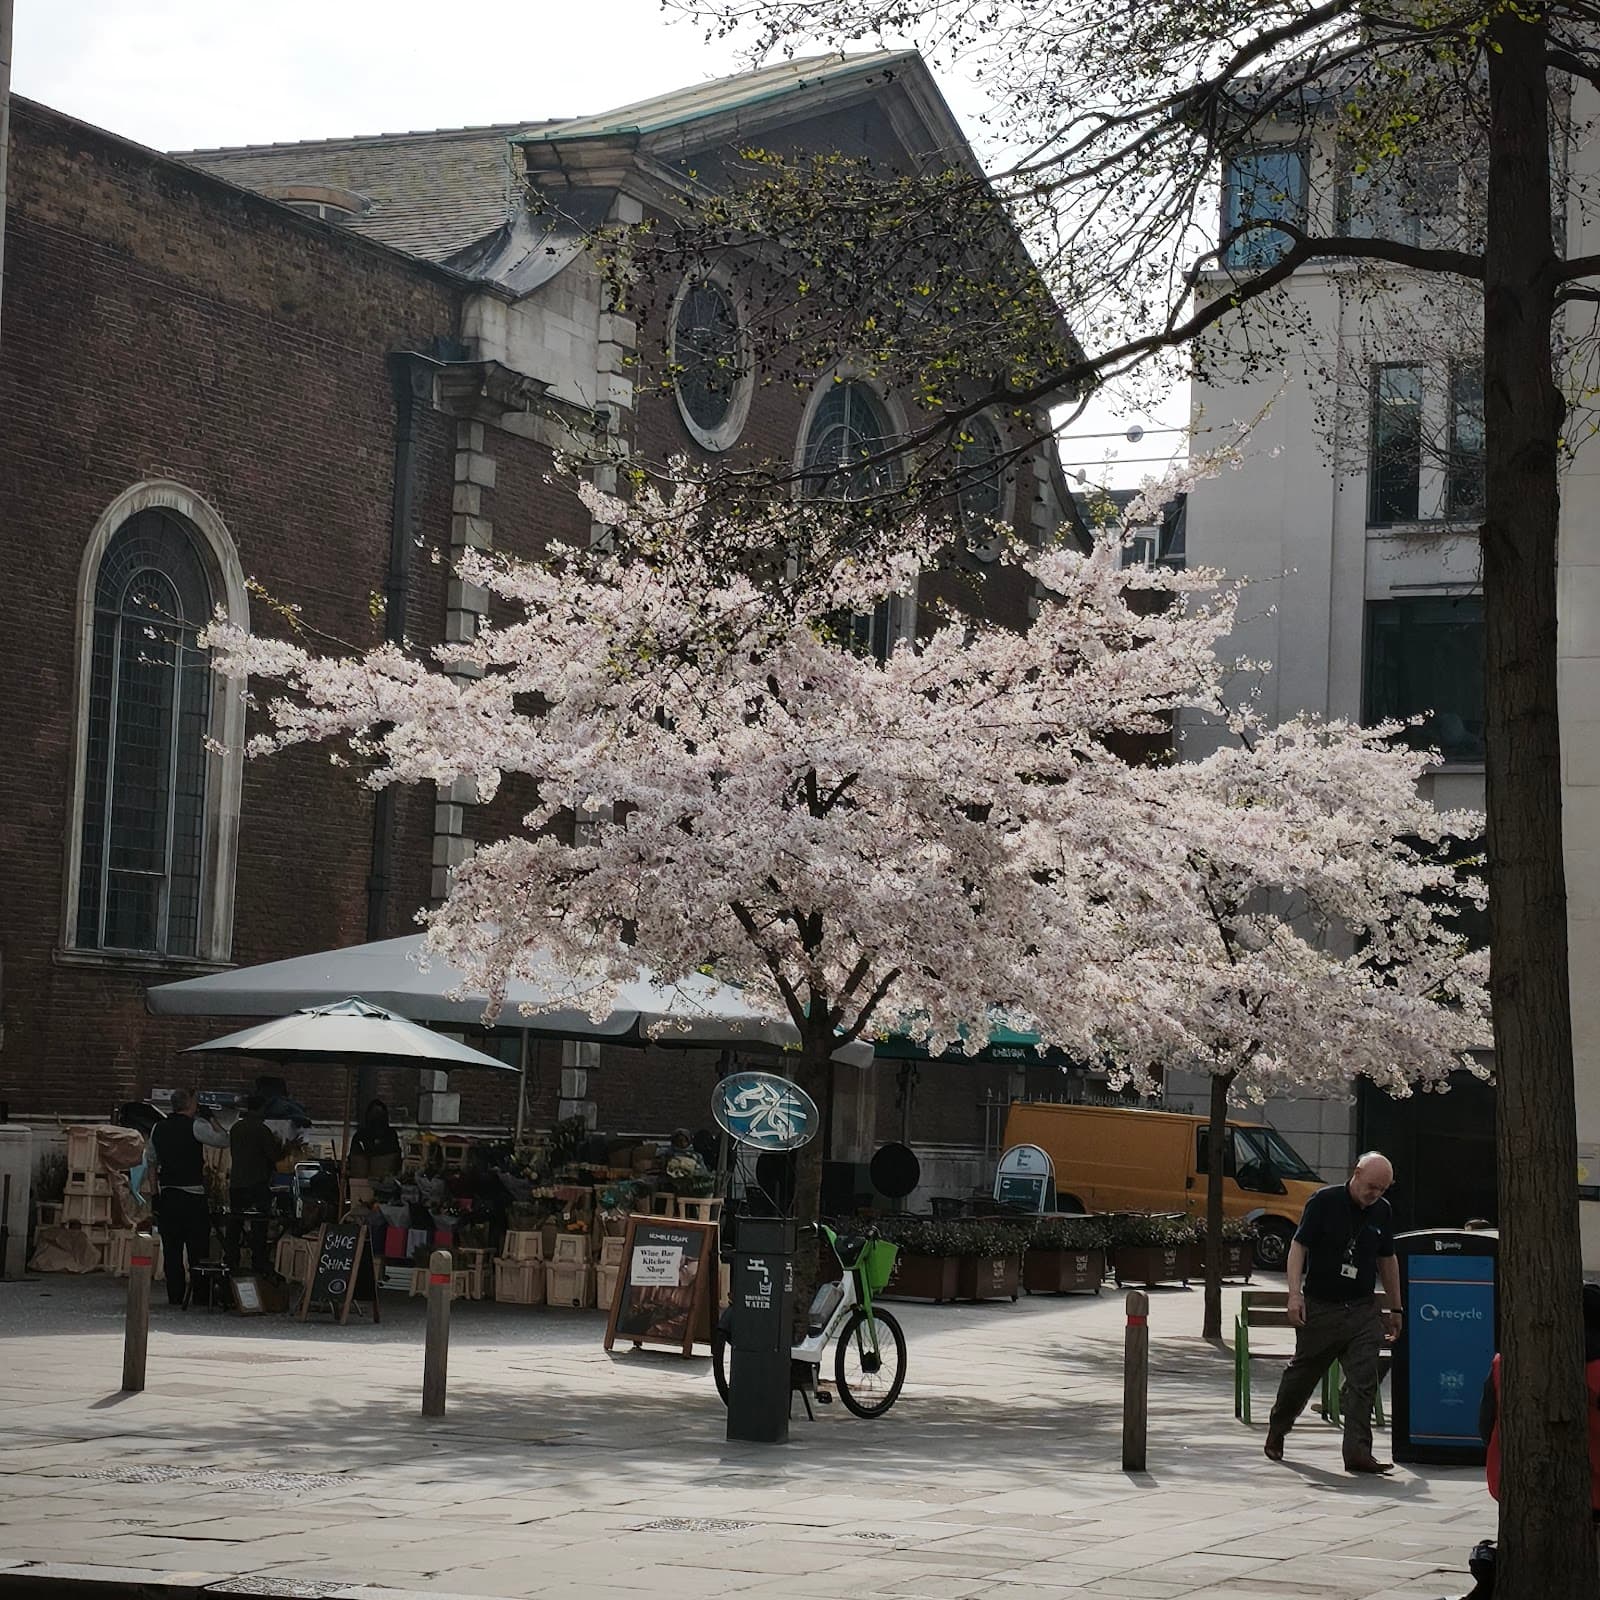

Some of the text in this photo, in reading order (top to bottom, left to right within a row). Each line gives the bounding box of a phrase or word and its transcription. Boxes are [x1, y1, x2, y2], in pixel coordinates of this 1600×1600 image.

[325, 1232, 356, 1250] SHOE
[640, 1249, 659, 1257] Wine
[319, 1254, 352, 1273] SHINE
[646, 1265, 665, 1275] Shop
[745, 1301, 770, 1310] WATER
[1441, 1307, 1483, 1321] recycle
